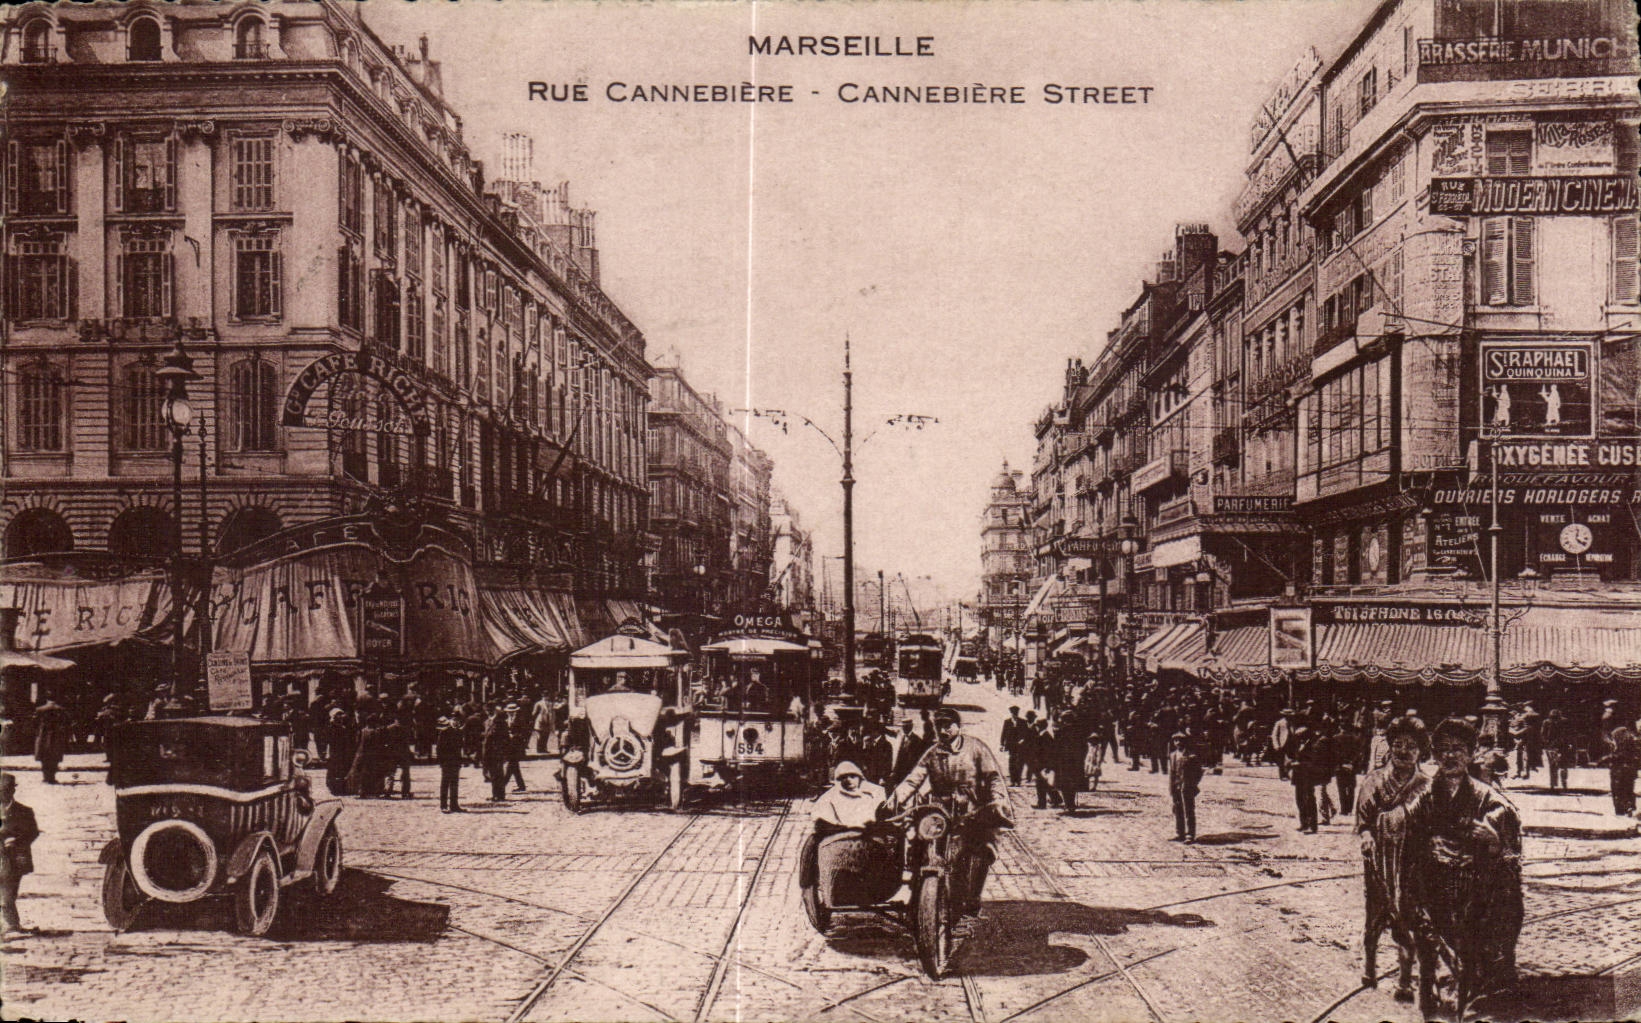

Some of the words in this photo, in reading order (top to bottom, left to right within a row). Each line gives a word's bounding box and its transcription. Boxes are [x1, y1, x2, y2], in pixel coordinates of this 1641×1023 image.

[1420, 40, 1516, 64] BRASSERIE
[1506, 368, 1572, 379] QUINQUINA
[1524, 490, 1622, 504] HORLOGERS
[1217, 498, 1288, 511] PARFUMERIE
[1540, 515, 1566, 523] VENTE
[1587, 515, 1611, 523] ACHAT
[734, 614, 783, 628] OMEGA
[737, 742, 764, 754] 594
